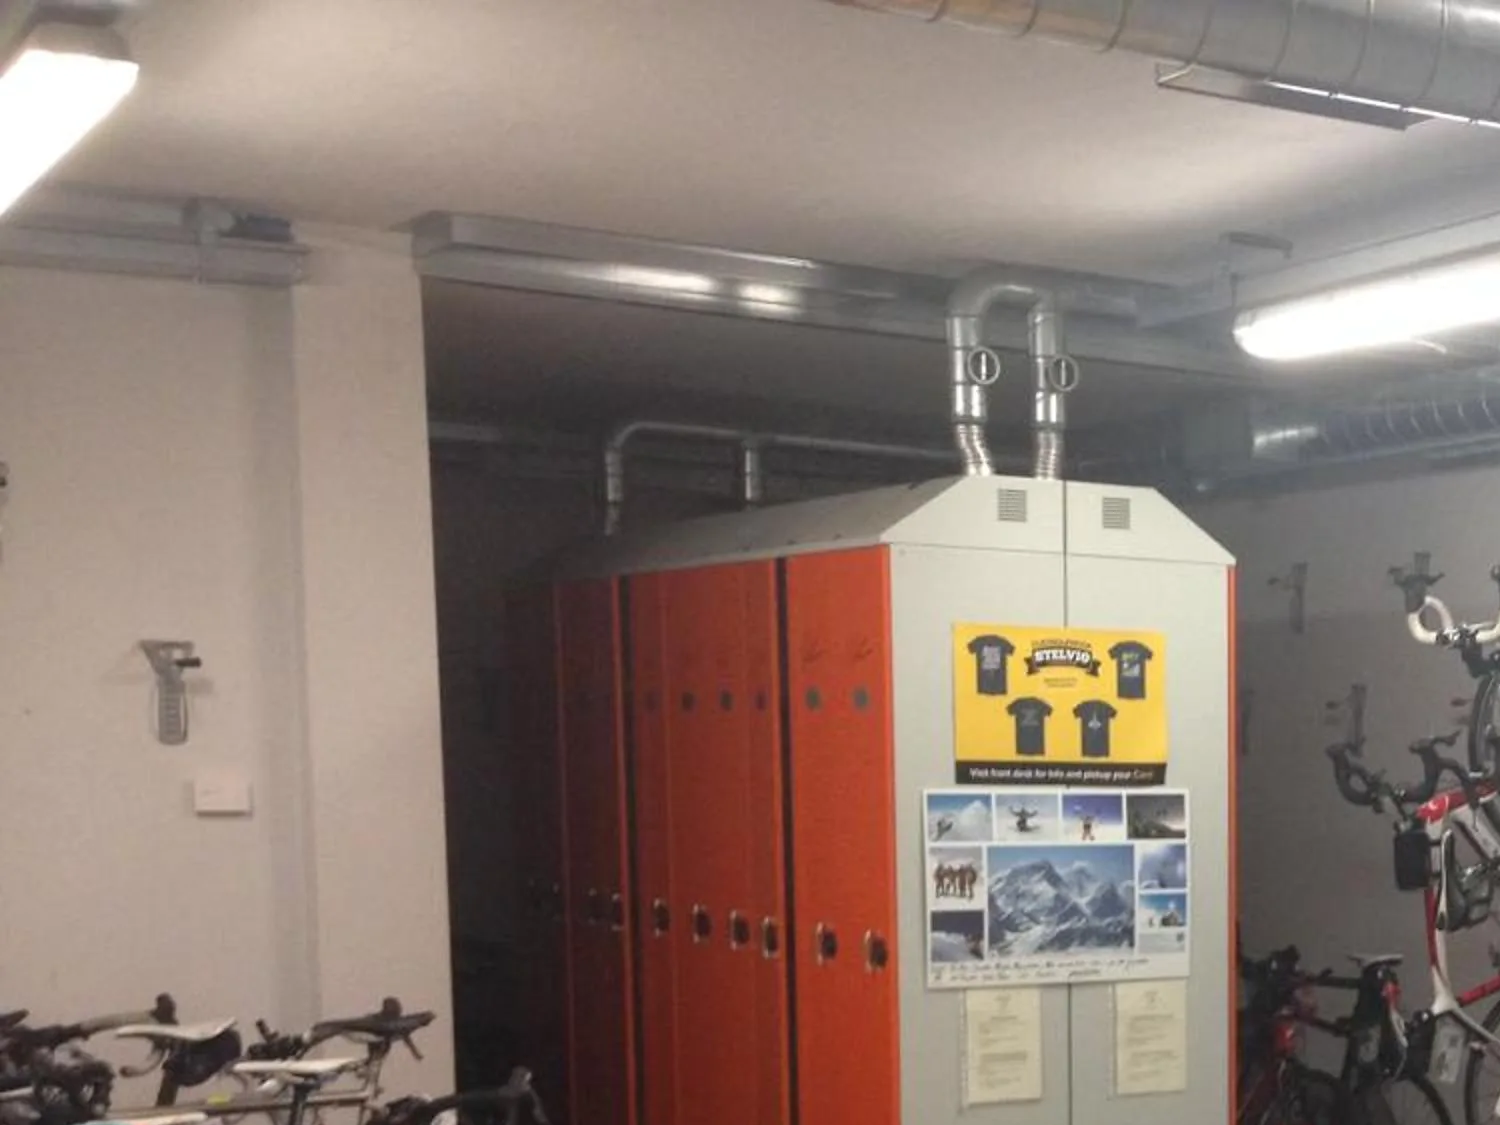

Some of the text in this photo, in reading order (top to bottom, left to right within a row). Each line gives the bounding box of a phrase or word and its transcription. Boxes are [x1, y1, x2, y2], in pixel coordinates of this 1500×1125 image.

[1034, 648, 1091, 664] STELVIO
[969, 767, 988, 777] Visit
[991, 767, 1010, 777] front
[1012, 768, 1032, 778] desk
[1035, 768, 1046, 778] for
[1048, 768, 1064, 778] info
[1066, 769, 1082, 778] and
[1083, 768, 1111, 781] pickup
[1113, 770, 1131, 781] your
